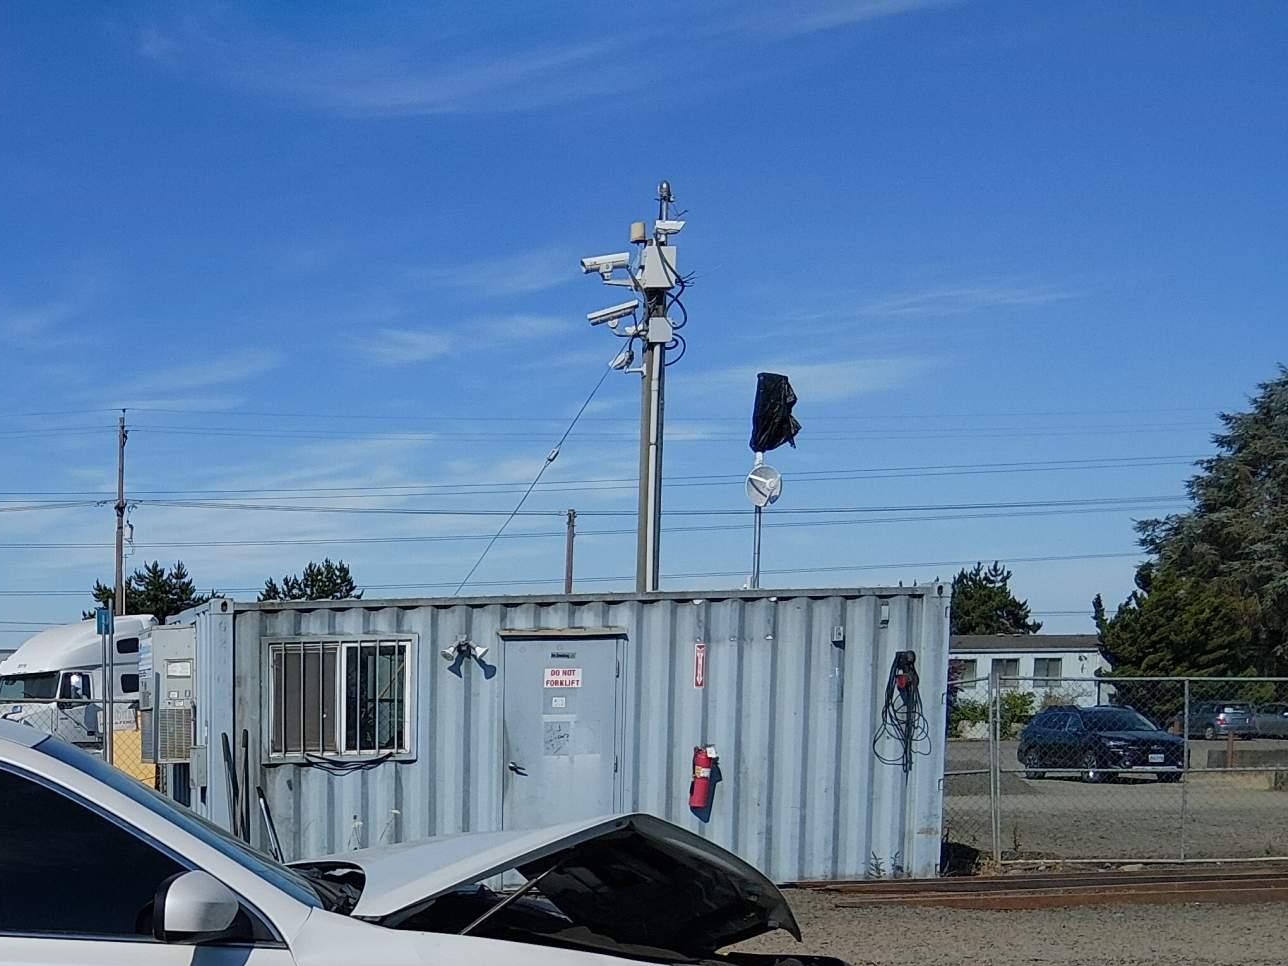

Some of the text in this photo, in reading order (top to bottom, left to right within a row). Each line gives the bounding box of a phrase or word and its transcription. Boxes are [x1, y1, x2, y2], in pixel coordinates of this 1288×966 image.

[551, 669, 576, 677] DO NOT
[546, 679, 580, 687] FORKLIFT
